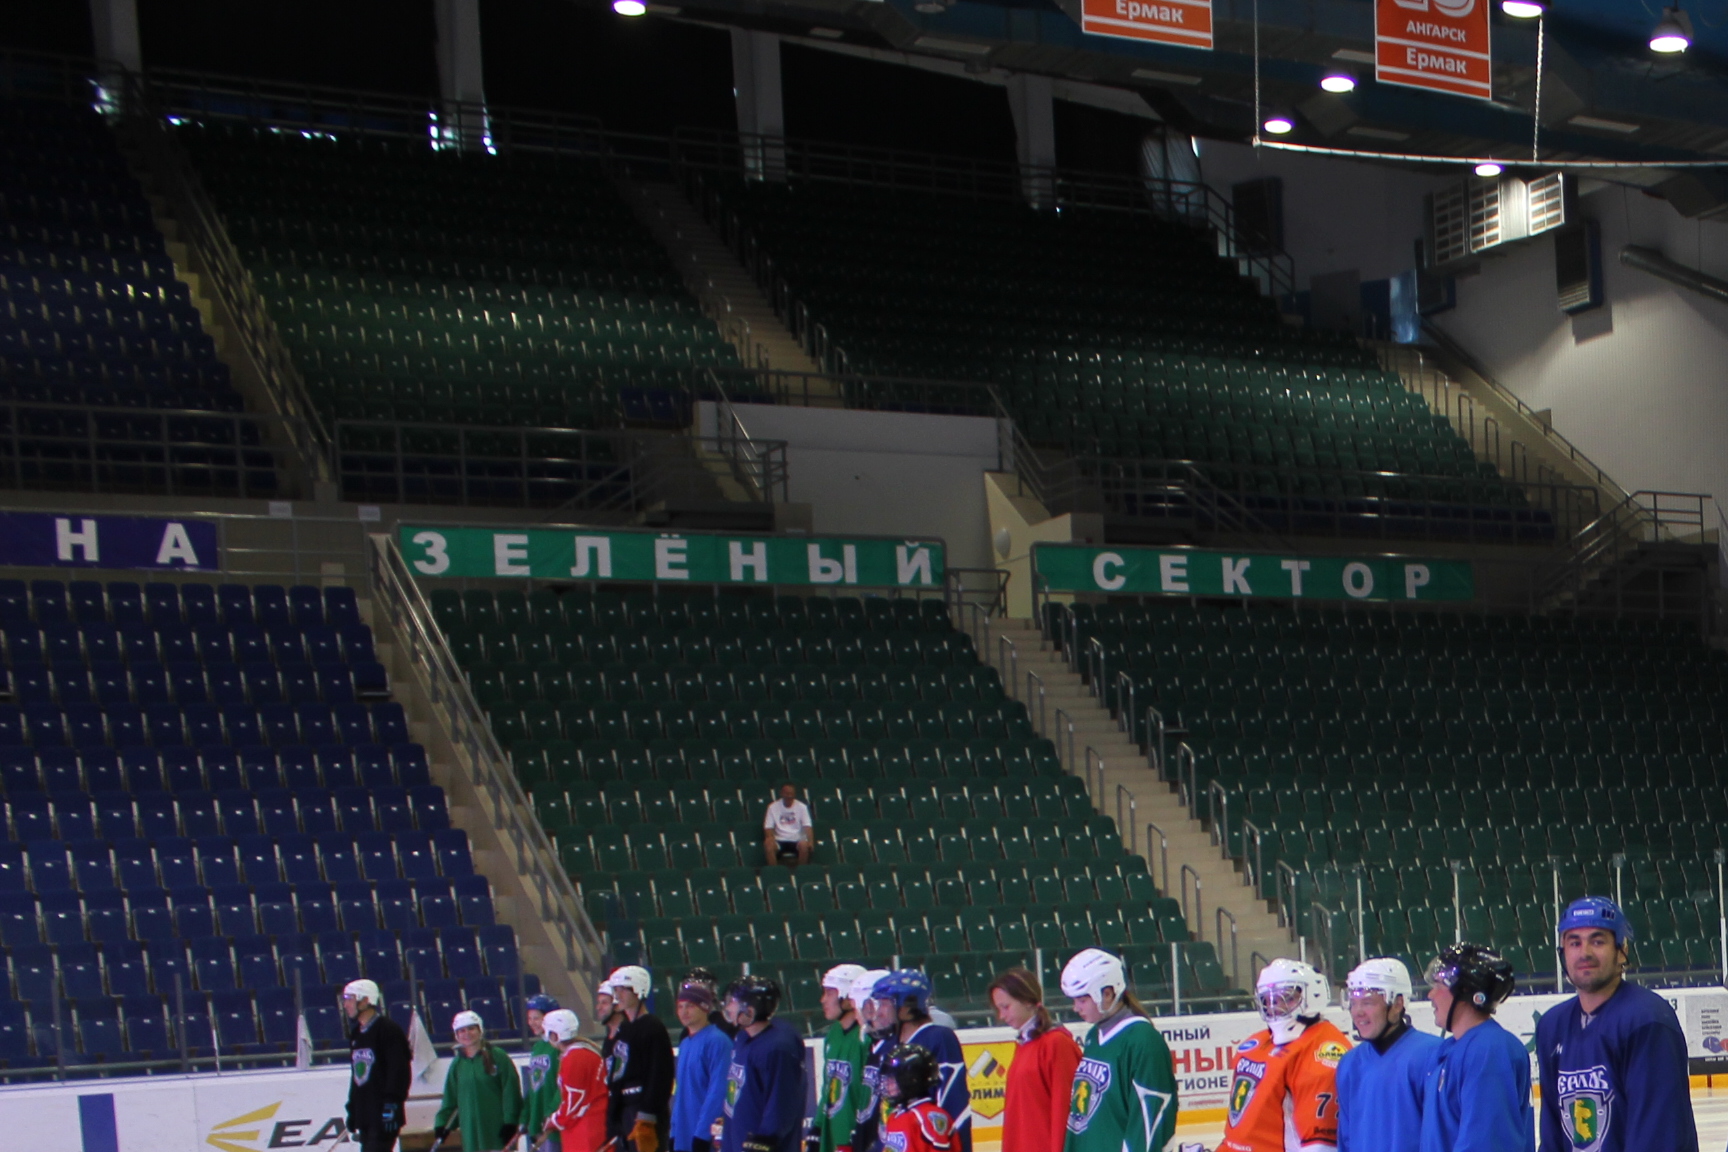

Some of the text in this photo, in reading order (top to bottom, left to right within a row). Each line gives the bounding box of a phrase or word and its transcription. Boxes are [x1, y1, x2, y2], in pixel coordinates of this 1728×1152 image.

[1115, 0, 1184, 24] Ермак
[1405, 19, 1467, 43] АНГАРСК
[1405, 47, 1468, 76] Ермак
[412, 530, 933, 586] ЗЕЛЁНЫЙ
[1092, 552, 1431, 600] СЕКТОР
